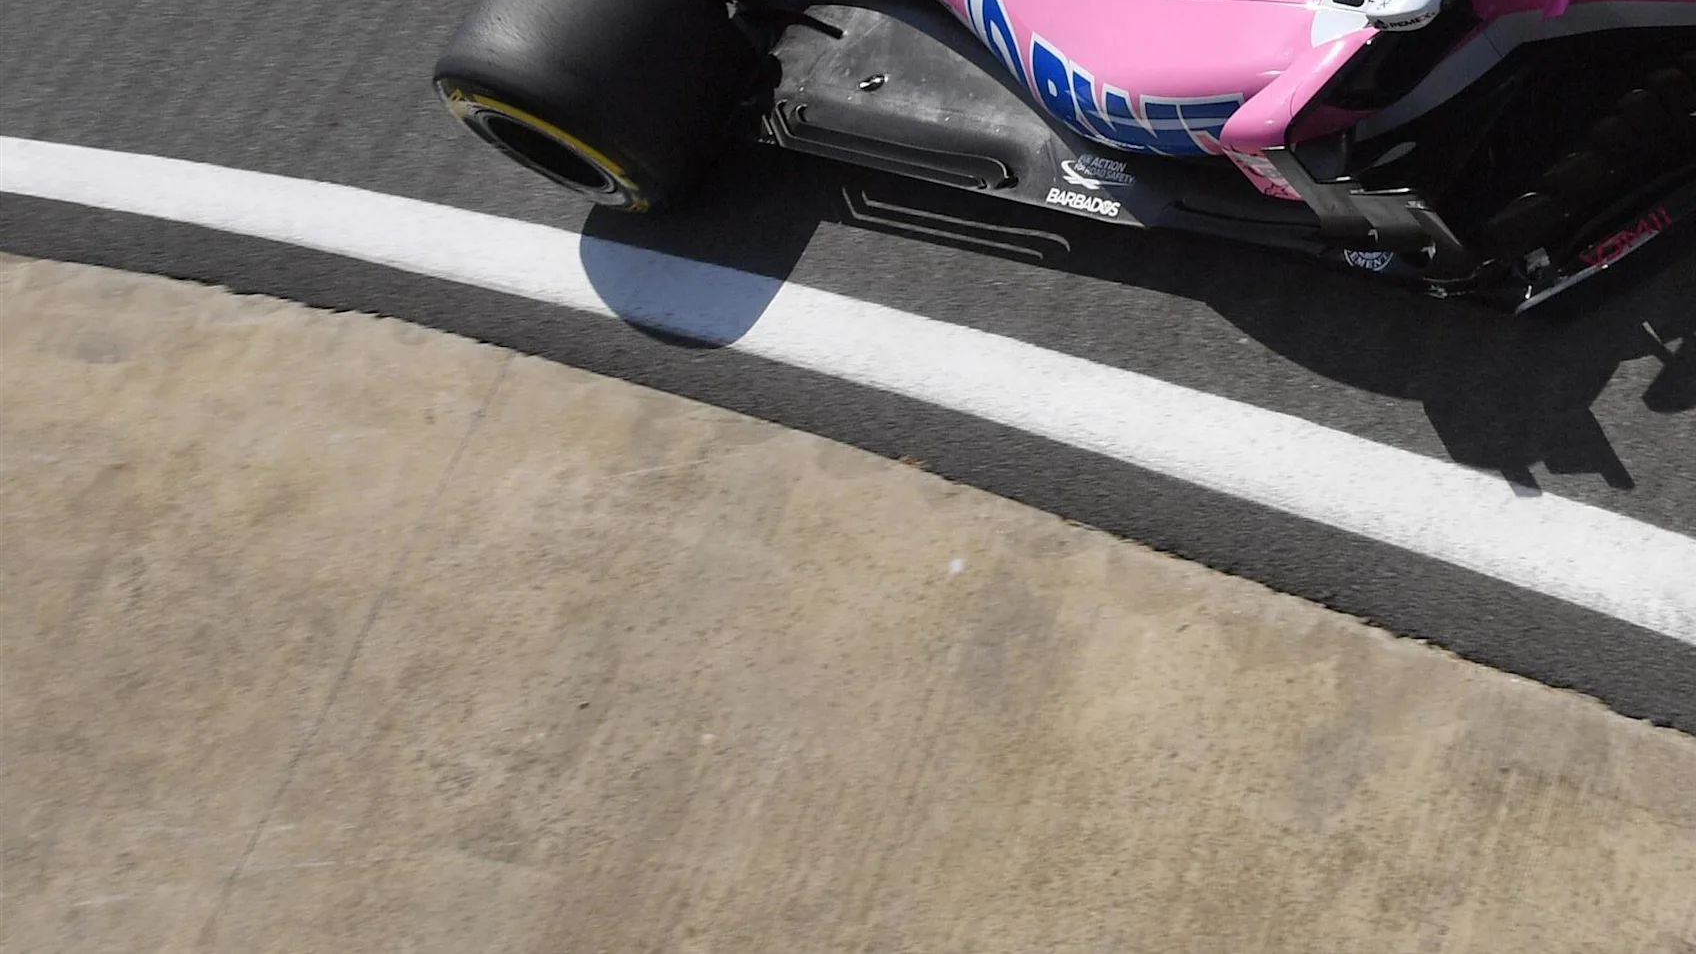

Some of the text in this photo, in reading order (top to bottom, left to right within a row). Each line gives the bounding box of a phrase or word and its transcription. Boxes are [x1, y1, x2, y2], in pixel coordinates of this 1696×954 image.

[1091, 157, 1128, 172] ACTION
[1105, 169, 1136, 184] SAFETY
[1046, 188, 1121, 217] BARBADOS
